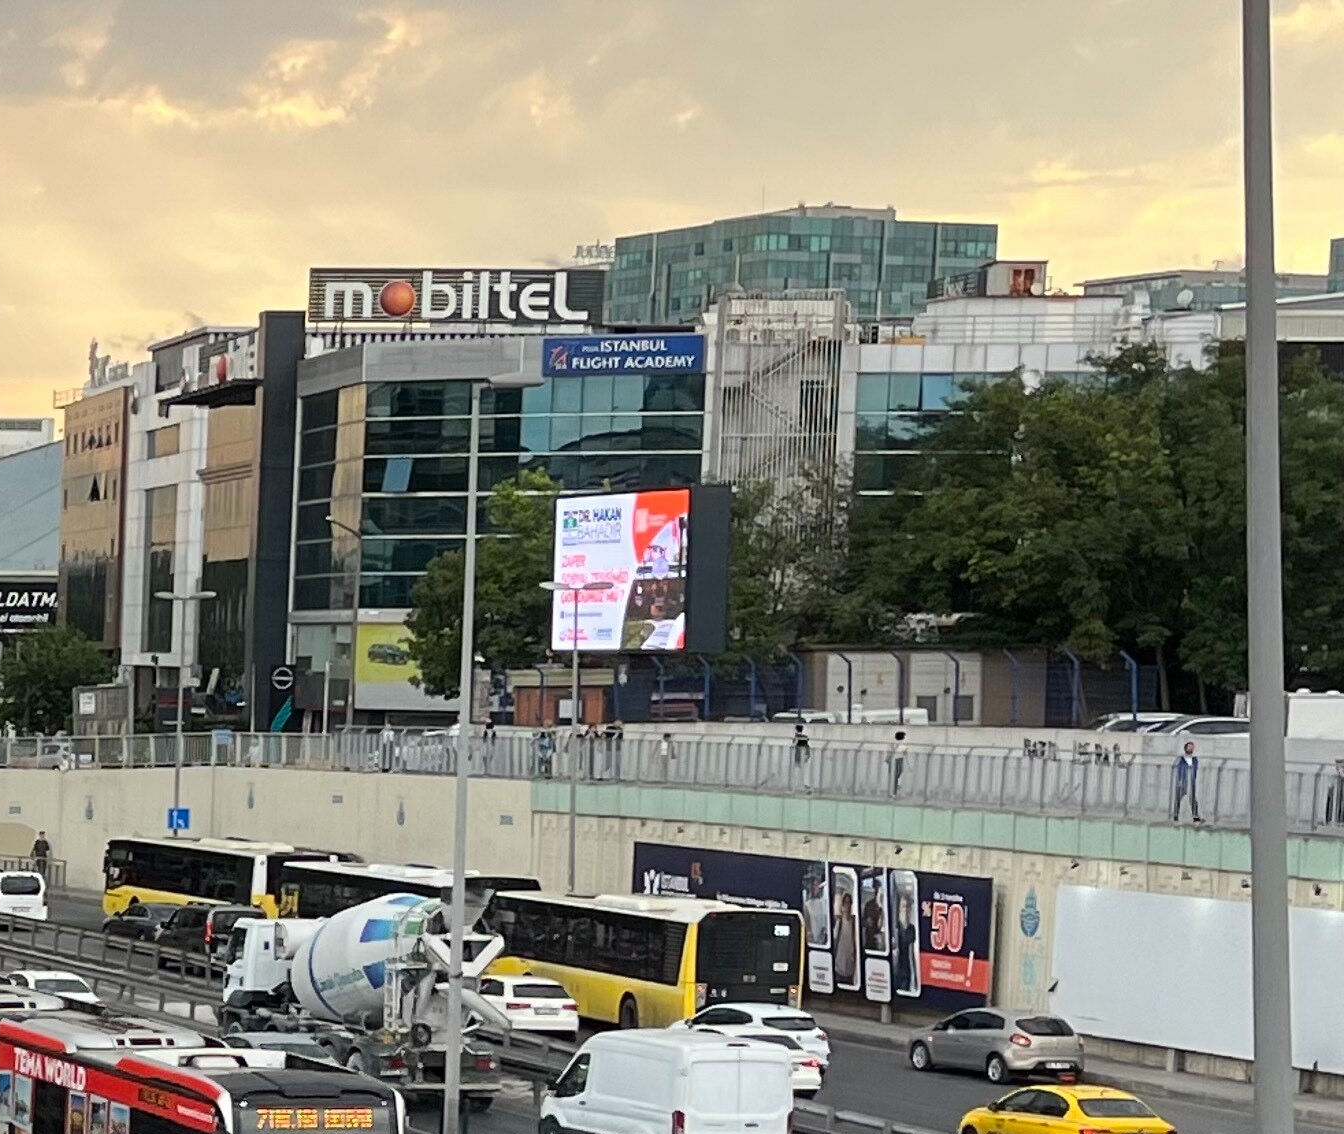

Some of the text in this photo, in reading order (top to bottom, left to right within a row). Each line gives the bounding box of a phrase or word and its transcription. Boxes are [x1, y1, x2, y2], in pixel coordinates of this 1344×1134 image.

[572, 355, 695, 369] FLIGHT ACADEMY
[14, 1047, 87, 1091] TEMA WORLD
